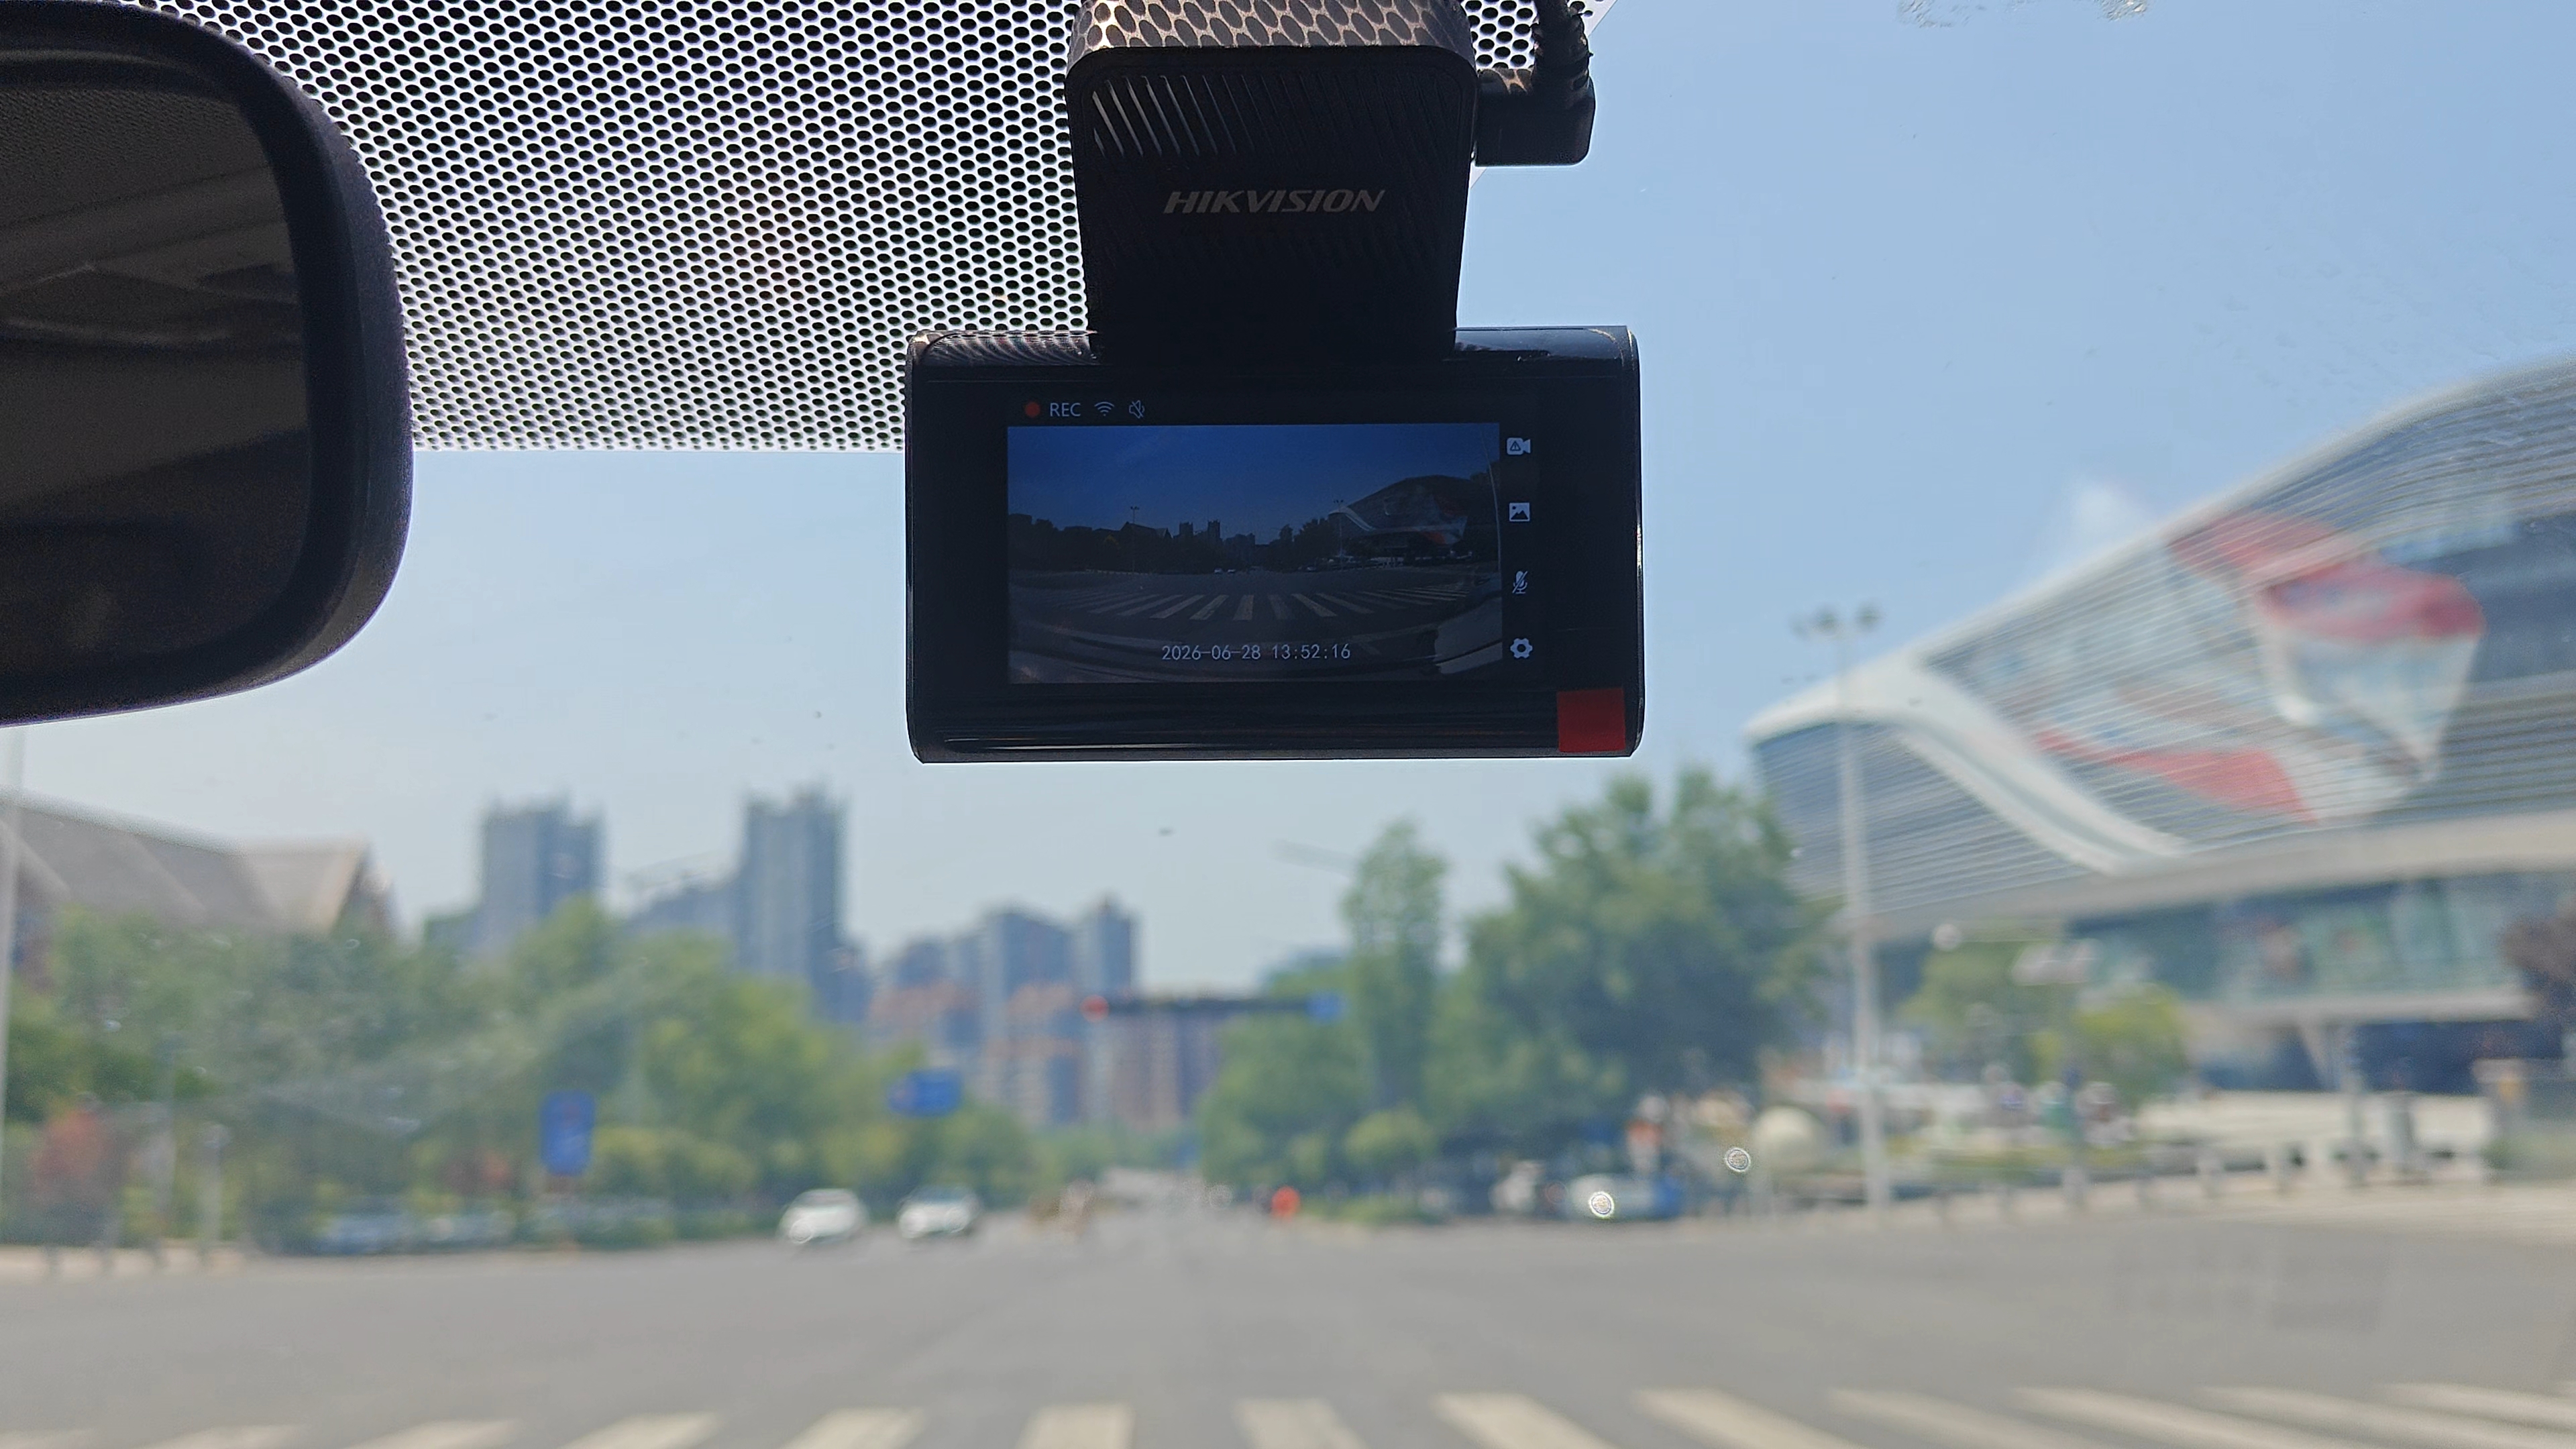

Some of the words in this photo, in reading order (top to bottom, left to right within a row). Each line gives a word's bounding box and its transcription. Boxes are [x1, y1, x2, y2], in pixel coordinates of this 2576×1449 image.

[1163, 189, 1385, 214] HIKVISION
[1050, 402, 1081, 417] REC
[1162, 645, 1261, 660] 2026-06-28
[1272, 643, 1350, 659] 13:52:16
